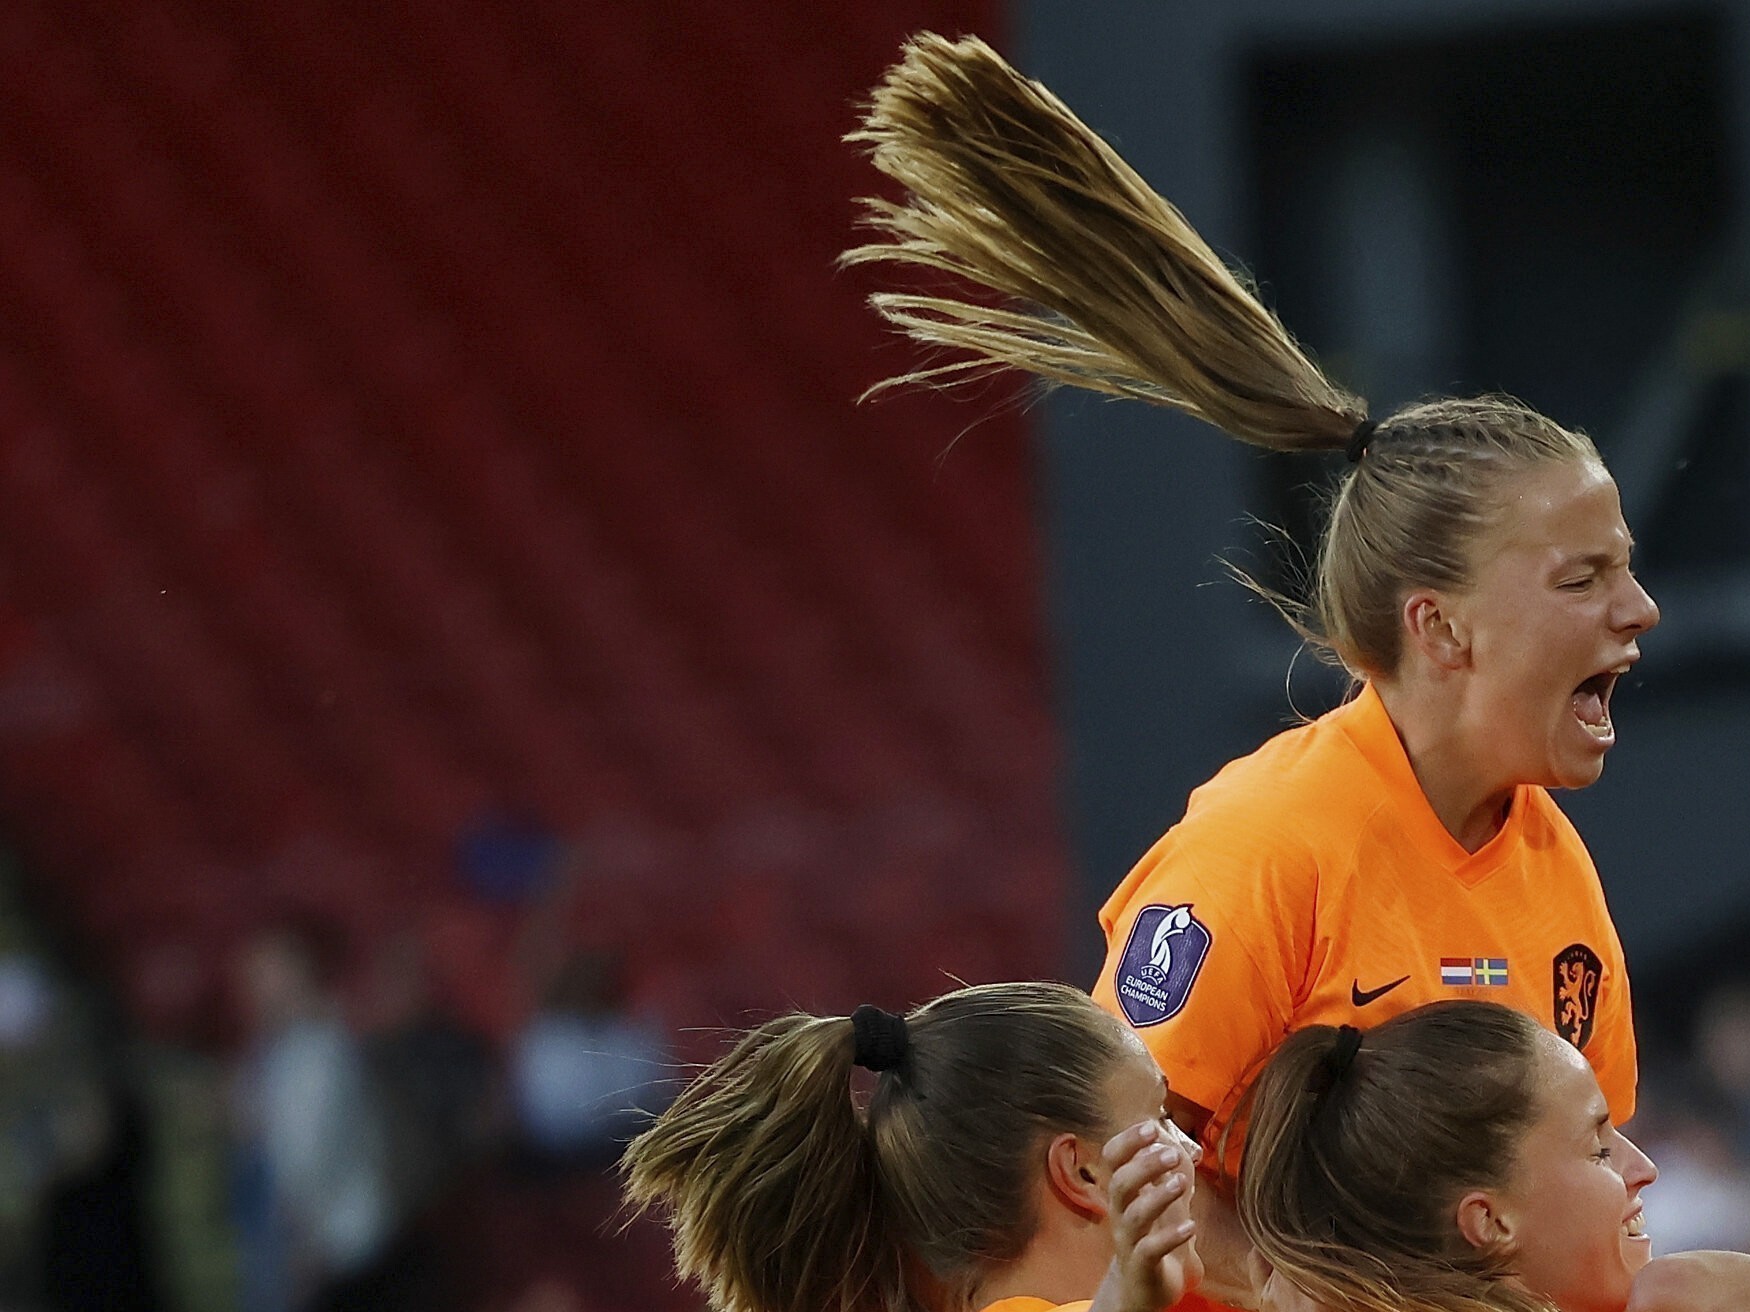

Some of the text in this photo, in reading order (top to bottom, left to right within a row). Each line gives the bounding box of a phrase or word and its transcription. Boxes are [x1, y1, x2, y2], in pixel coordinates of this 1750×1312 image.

[1125, 975, 1169, 1001] EUROPEAN
[1141, 967, 1164, 984] UEFA
[1120, 984, 1167, 1012] CHAMPIONS
